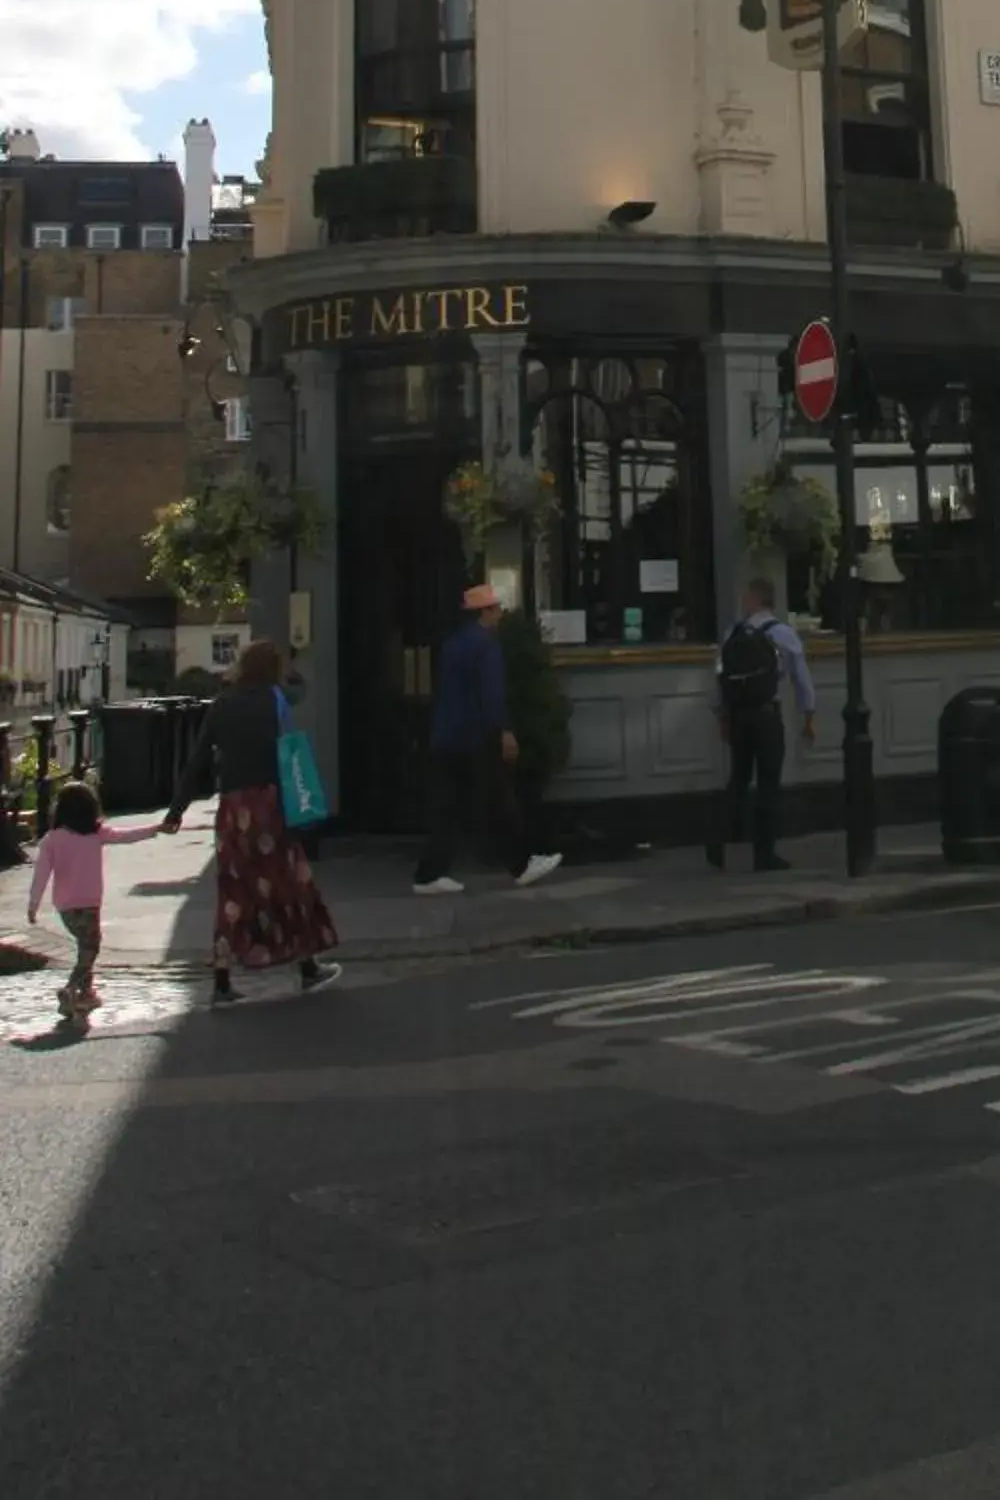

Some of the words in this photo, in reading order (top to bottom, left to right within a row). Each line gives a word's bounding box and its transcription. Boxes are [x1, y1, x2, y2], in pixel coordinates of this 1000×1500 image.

[287, 298, 354, 349] THE
[370, 284, 531, 337] MITRE
[468, 962, 888, 1028] NO
